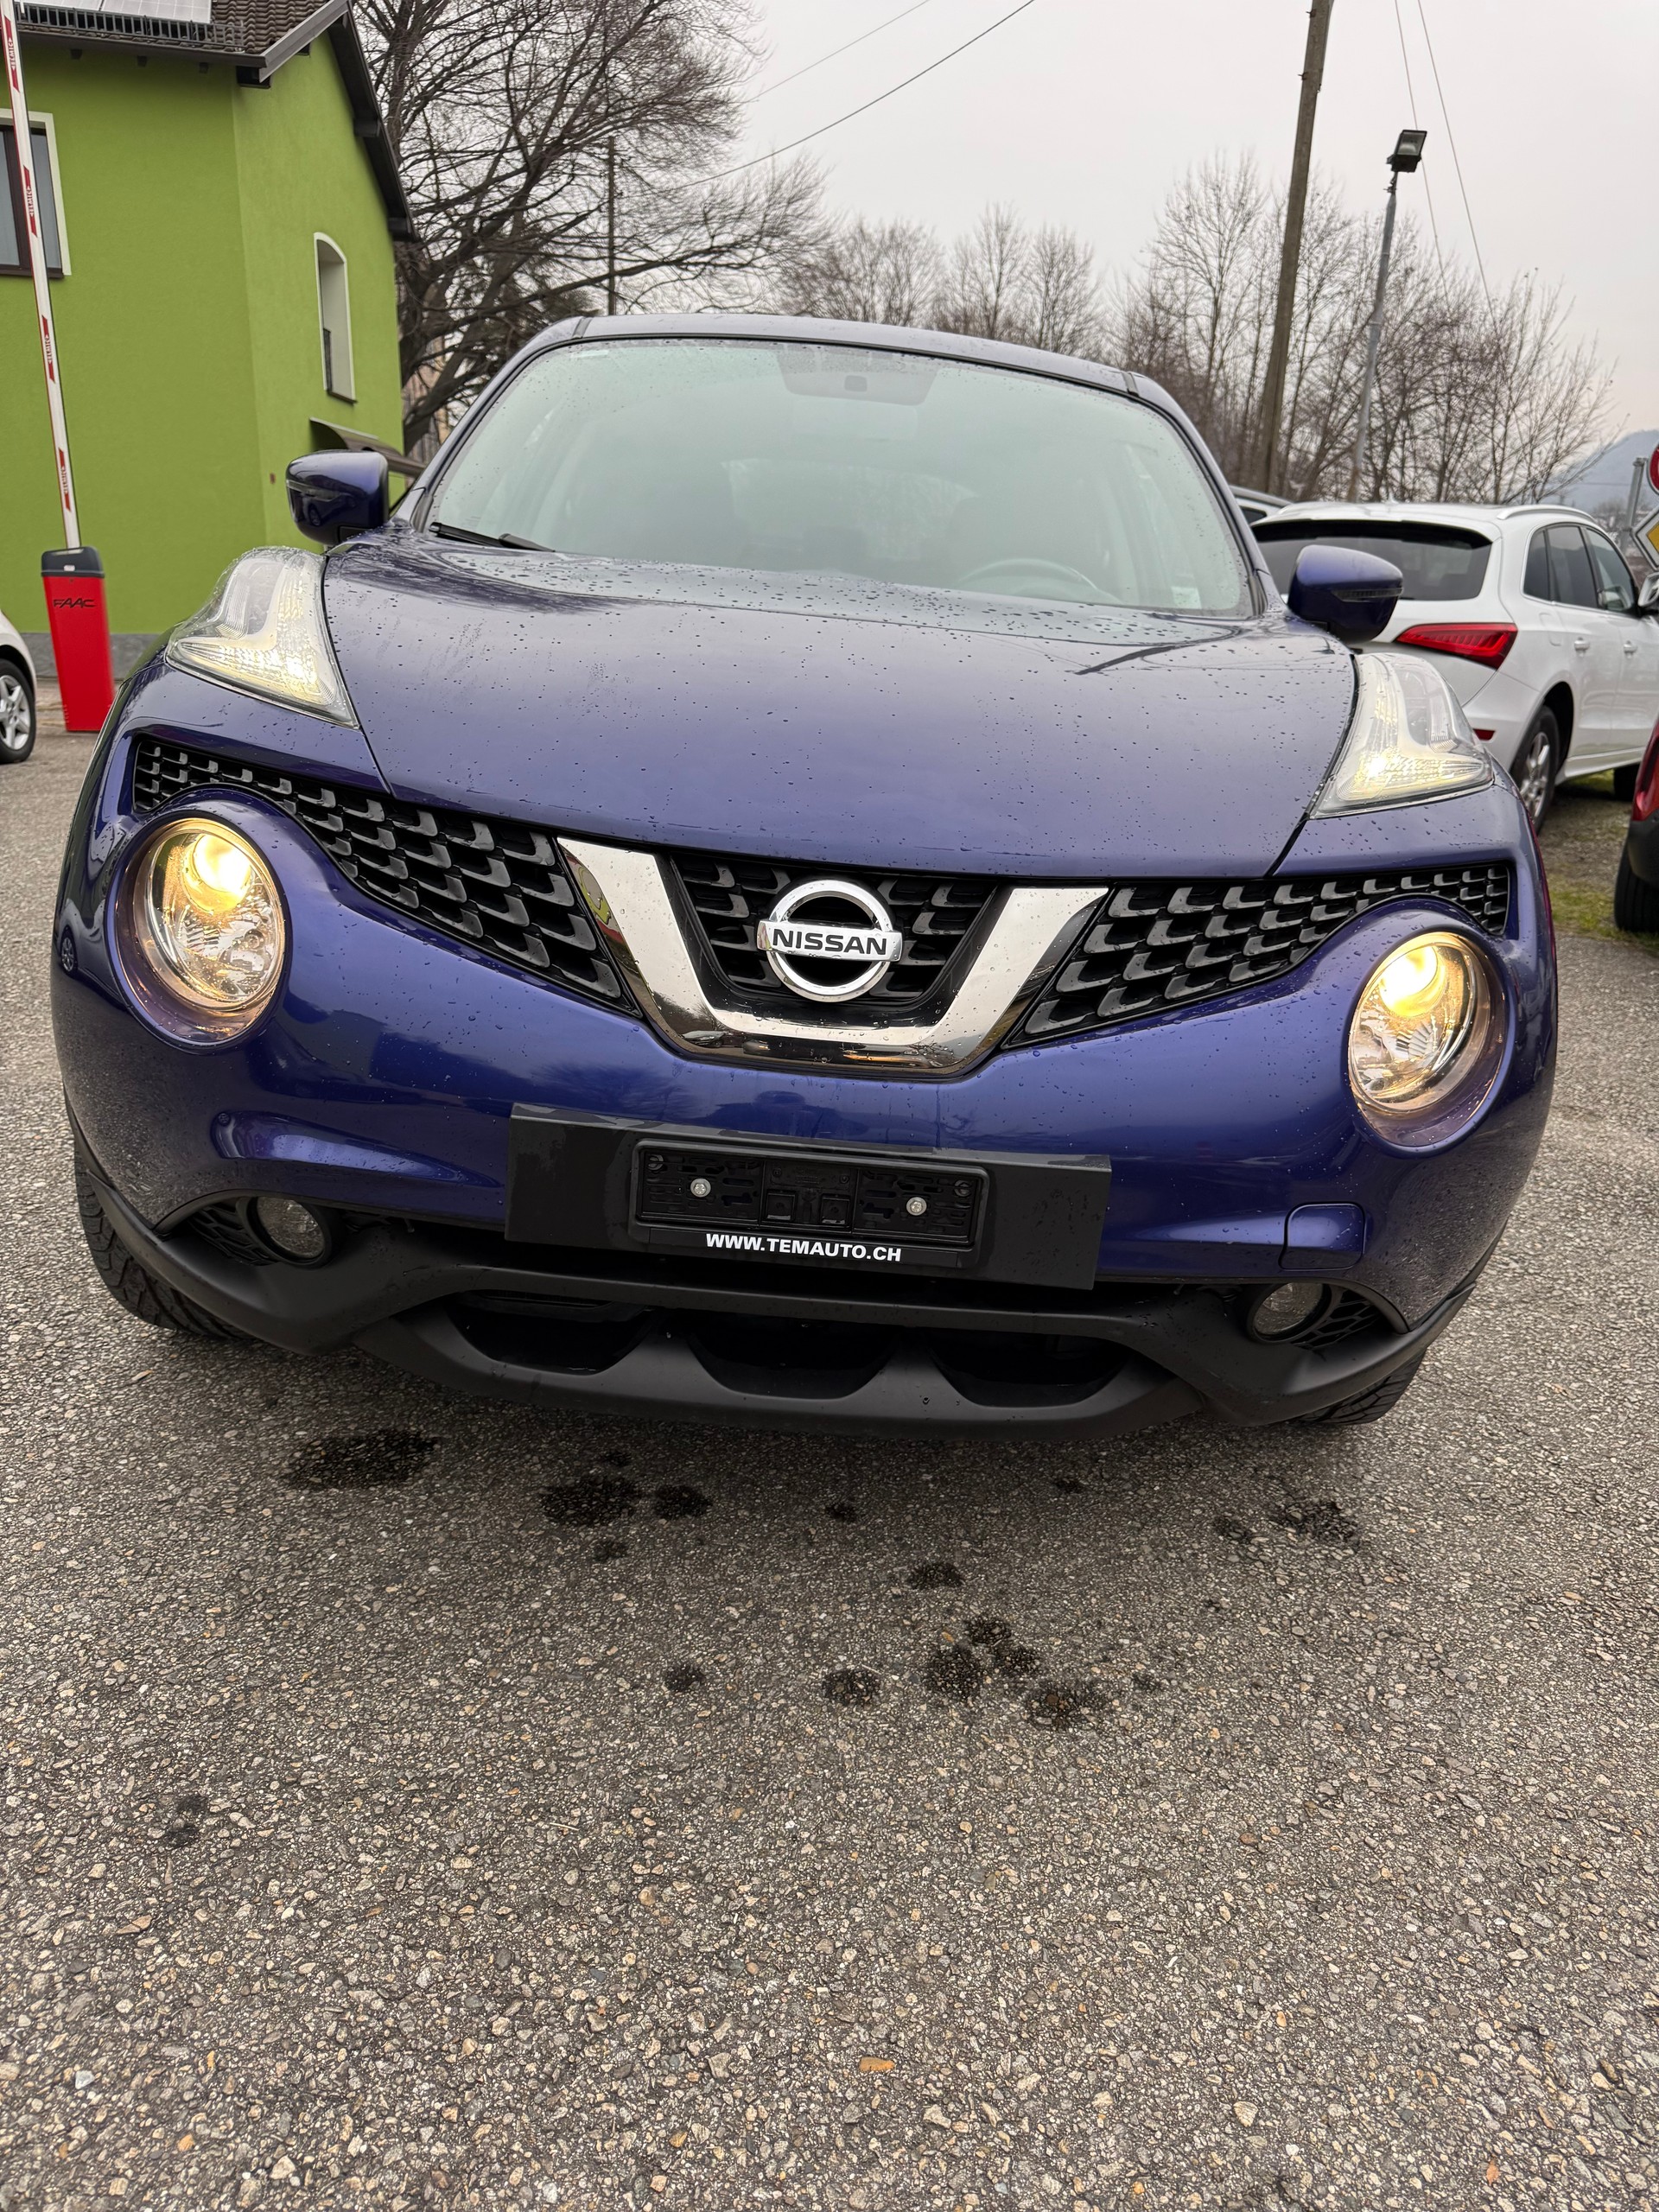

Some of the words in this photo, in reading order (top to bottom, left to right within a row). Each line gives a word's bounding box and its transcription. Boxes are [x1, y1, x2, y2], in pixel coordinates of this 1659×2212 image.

[53, 598, 95, 608] FAAC
[772, 929, 887, 955] NISSAN
[706, 1233, 901, 1262] WWW.TEMAUTO.CH
